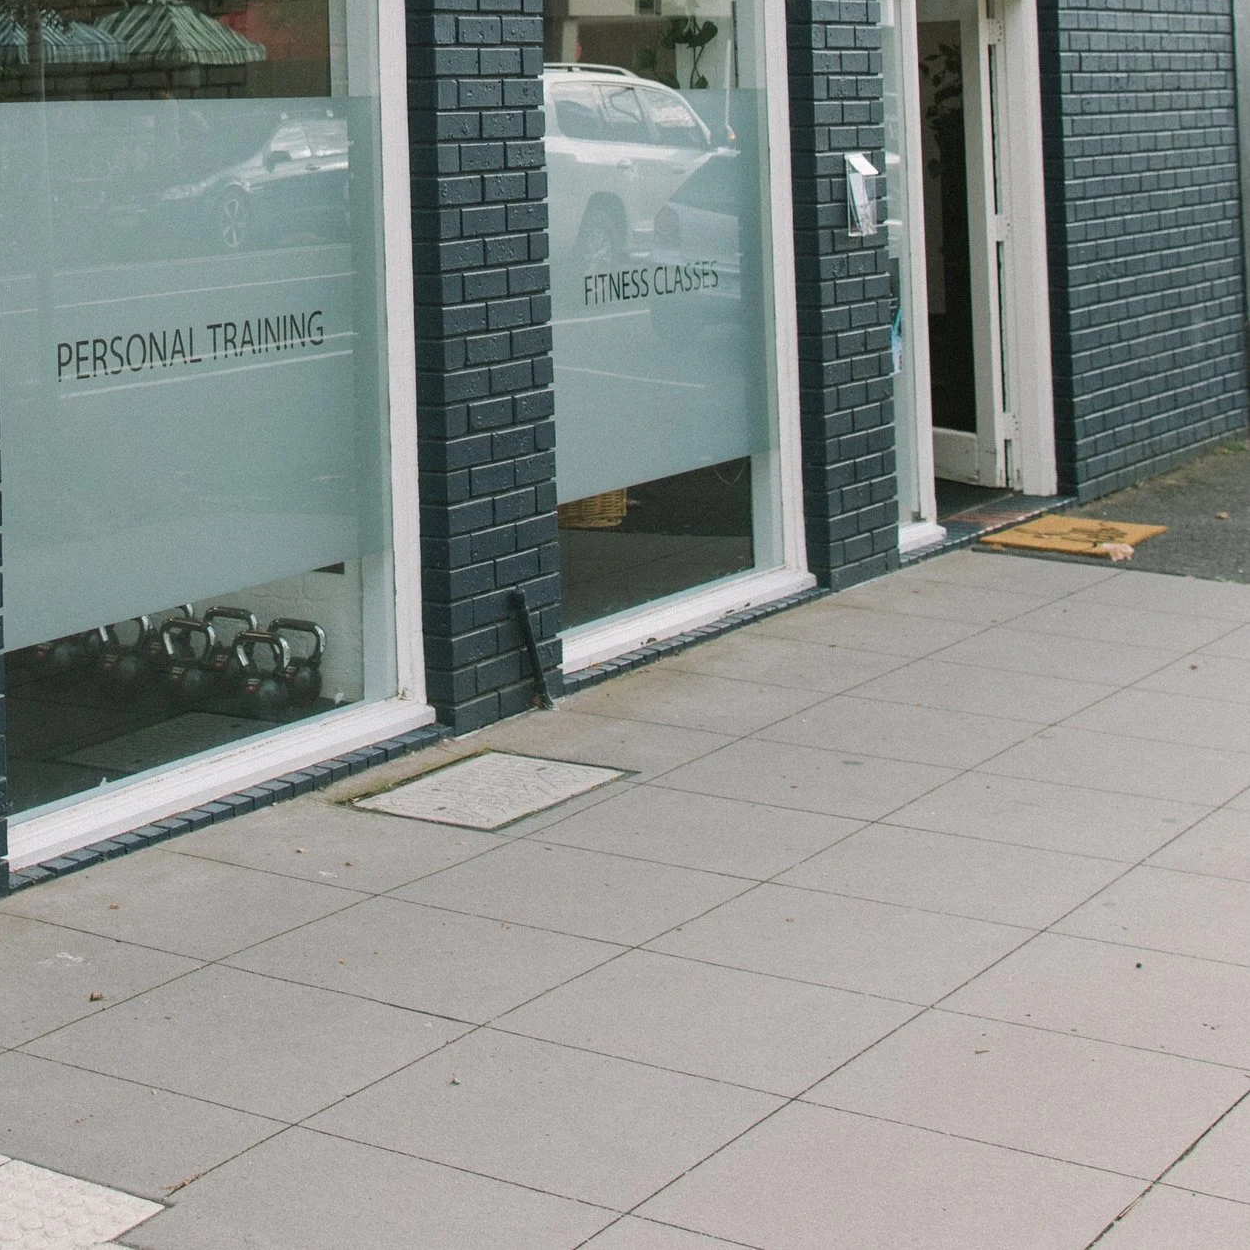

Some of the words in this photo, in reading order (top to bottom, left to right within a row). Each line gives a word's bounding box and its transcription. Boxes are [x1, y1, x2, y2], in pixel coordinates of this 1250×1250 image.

[584, 268, 649, 305] FITNESS
[653, 260, 719, 296] CLASSES
[57, 327, 202, 382] PERSONAL
[207, 310, 324, 360] TRAINING
